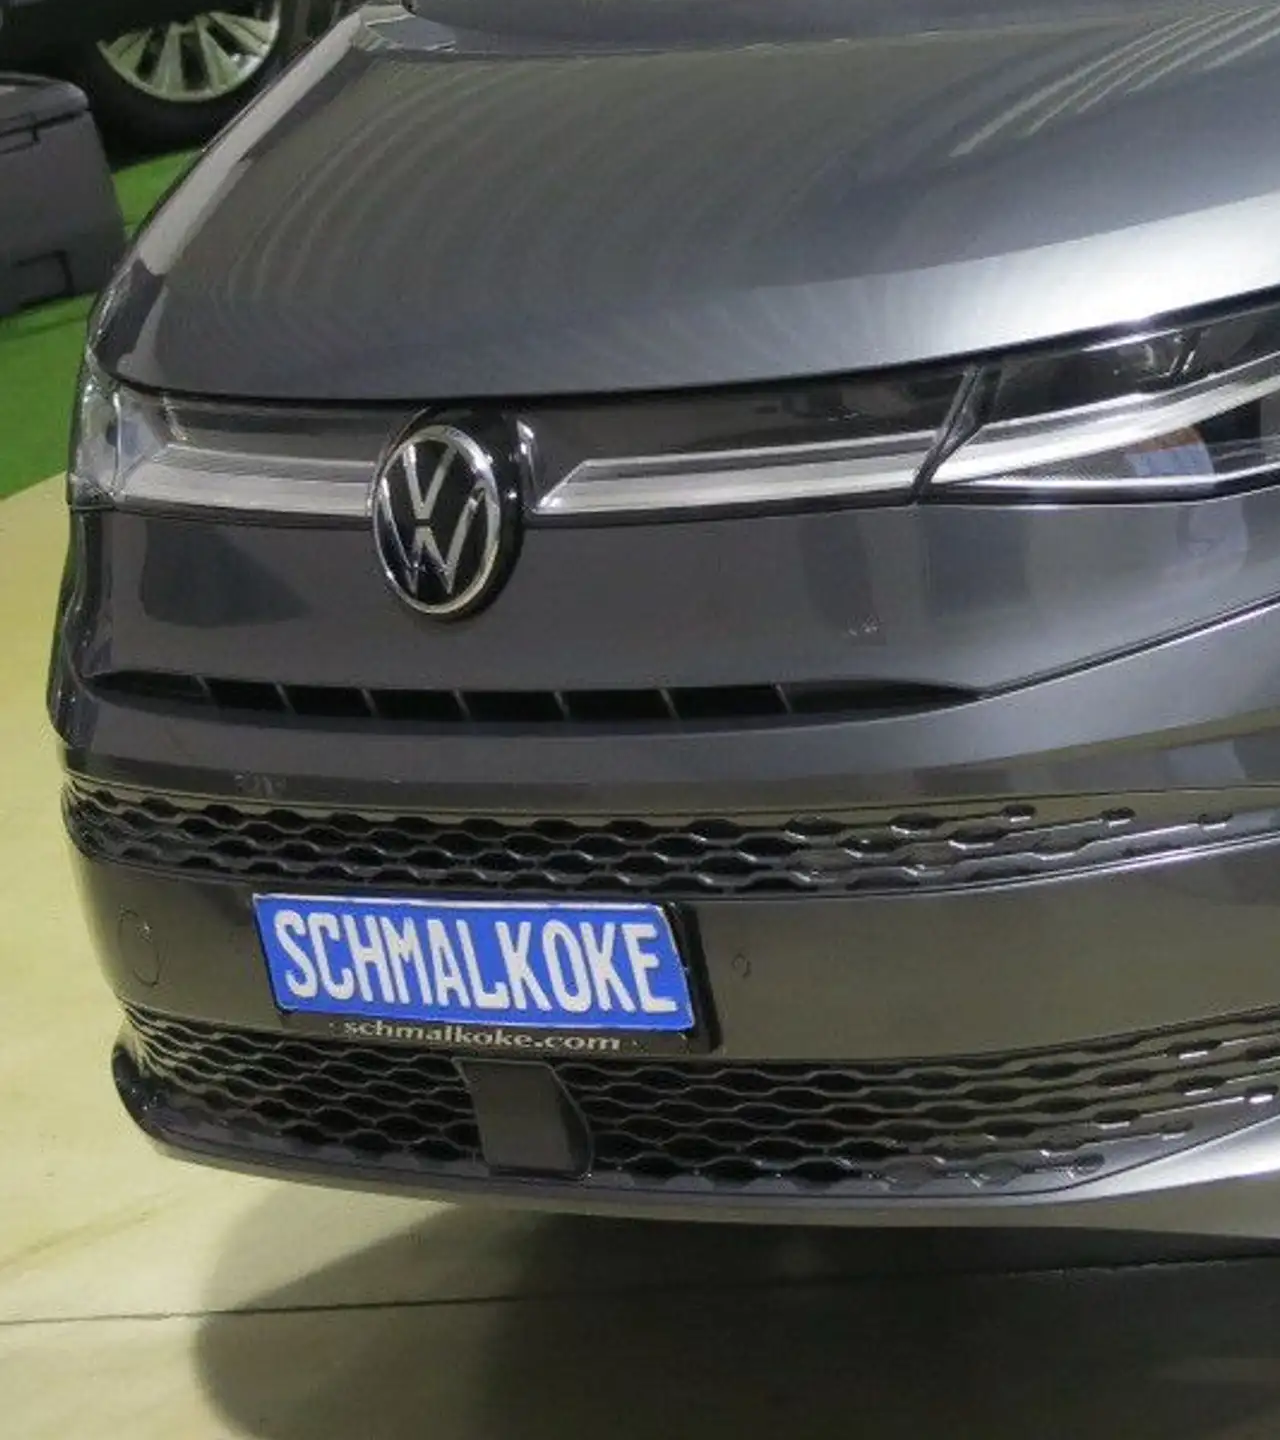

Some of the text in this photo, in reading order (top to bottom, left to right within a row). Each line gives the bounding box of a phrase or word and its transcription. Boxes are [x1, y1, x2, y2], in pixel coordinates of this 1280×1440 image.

[376, 428, 496, 608] VW
[273, 909, 678, 1014] SCHMALKOKE
[343, 1019, 622, 1051] schmalkoke.com
